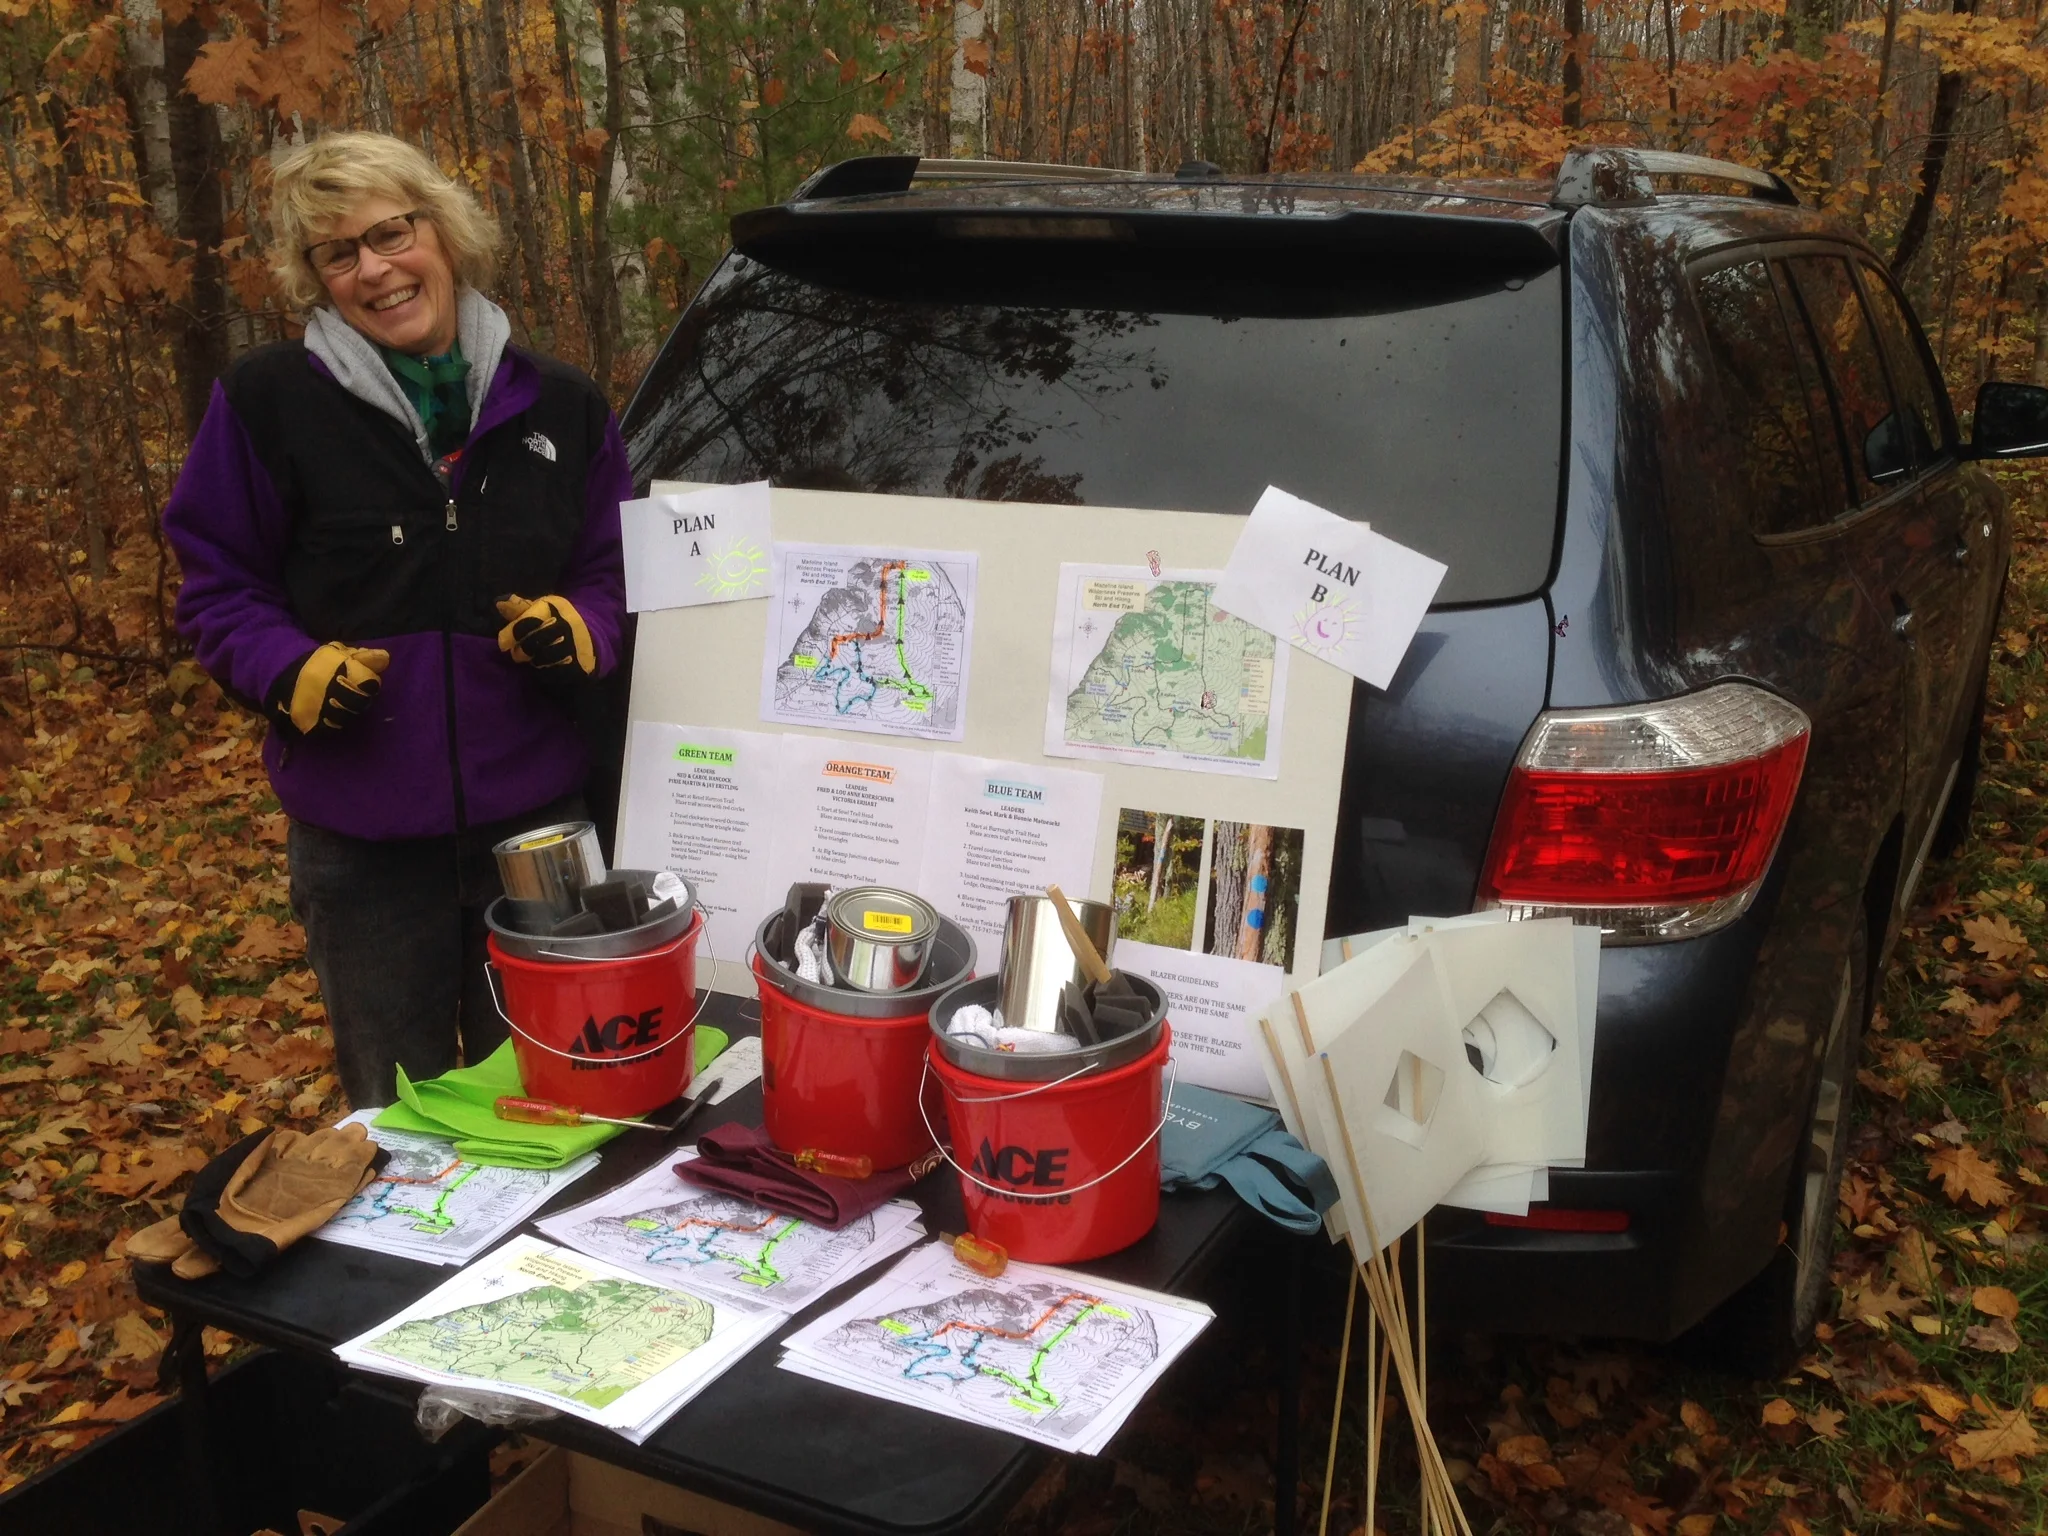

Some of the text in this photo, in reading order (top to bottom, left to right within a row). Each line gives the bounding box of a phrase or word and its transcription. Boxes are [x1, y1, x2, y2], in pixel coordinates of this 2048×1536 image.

[522, 437, 547, 448] NORTH
[533, 432, 548, 441] THE
[529, 443, 547, 456] FACE
[672, 514, 716, 534] PLAN
[690, 541, 701, 557] A
[1303, 548, 1362, 588] PLAN
[1310, 583, 1329, 603] B
[679, 749, 732, 761] GREEN TEAM
[826, 763, 890, 779] ORANGE TEAM
[988, 784, 1042, 800] BLUE TEAM
[1003, 850, 1026, 858] clockwise
[1014, 866, 1030, 874] circles
[1151, 970, 1219, 988] BLAZER GUIDELINES
[1178, 1004, 1193, 1012] AND
[1194, 1007, 1208, 1015] THE
[1210, 1009, 1229, 1018] SAME
[1184, 995, 1198, 1003] ARE
[1211, 1000, 1225, 1008] THE
[1227, 1003, 1246, 1012] SAME
[568, 1005, 664, 1053] ACE
[1181, 1032, 1193, 1040] SEE
[1194, 1034, 1208, 1043] THE
[1211, 1038, 1242, 1050] BLAZERS
[1191, 1044, 1204, 1053] THE
[1206, 1047, 1226, 1056] TRAIL
[522, 1102, 547, 1111] STANLEY
[971, 1136, 1070, 1187] ACE
